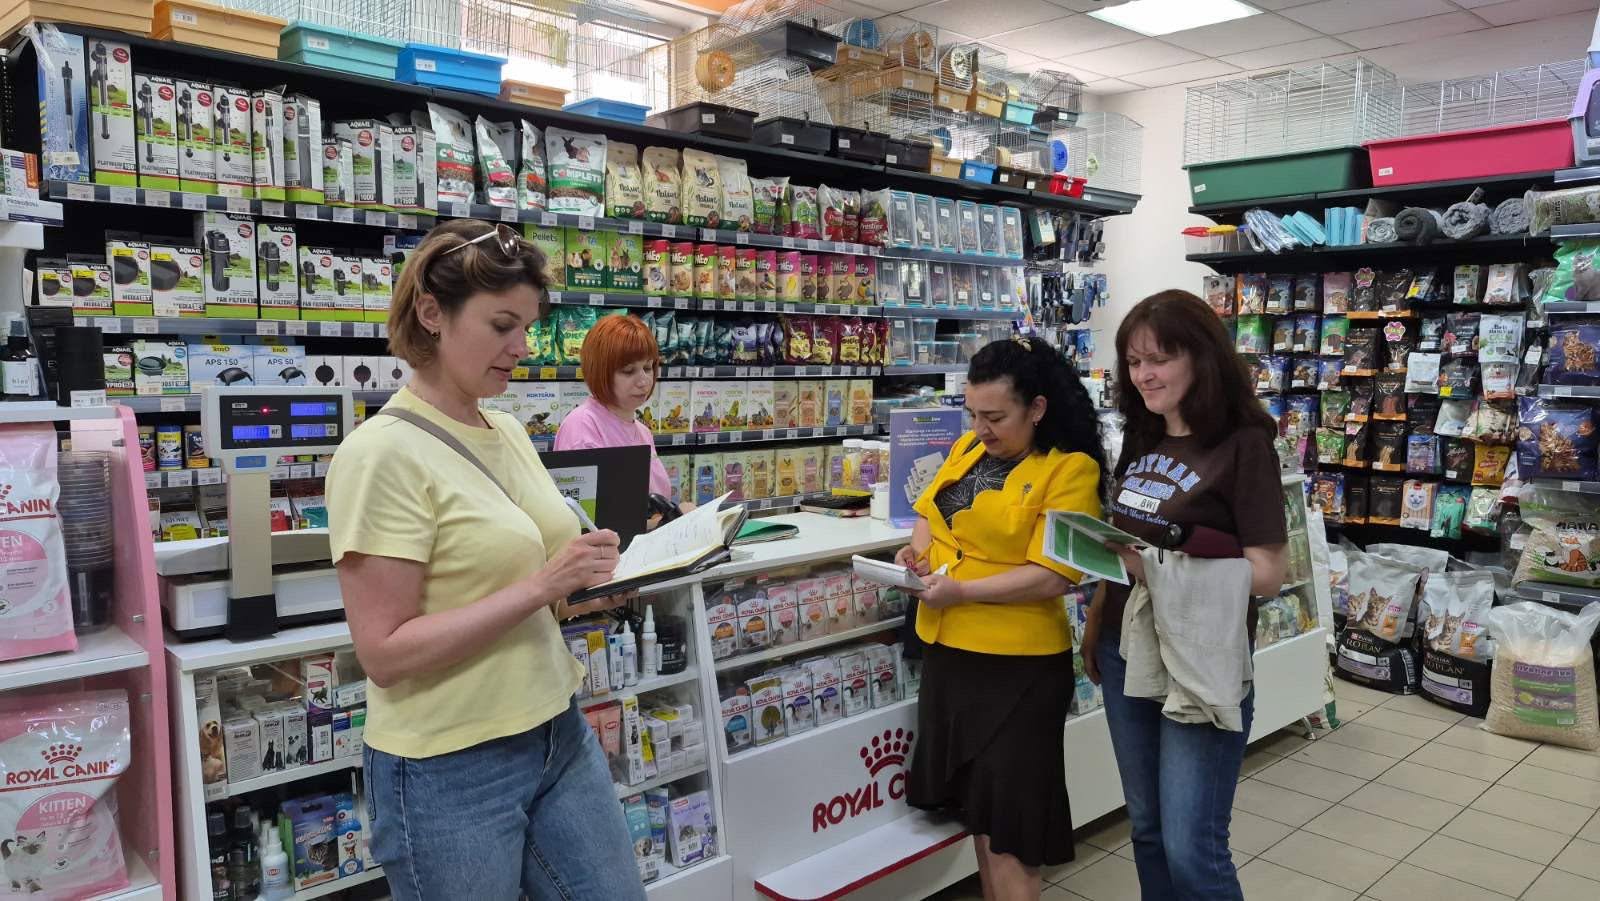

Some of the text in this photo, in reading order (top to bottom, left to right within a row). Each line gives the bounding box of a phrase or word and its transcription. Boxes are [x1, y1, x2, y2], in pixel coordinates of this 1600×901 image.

[205, 358, 238, 366] APS 150
[267, 358, 294, 366] APS 50
[6, 767, 59, 785] ROYAL
[39, 796, 86, 814] KITTEN
[812, 781, 884, 833] ROYAL
